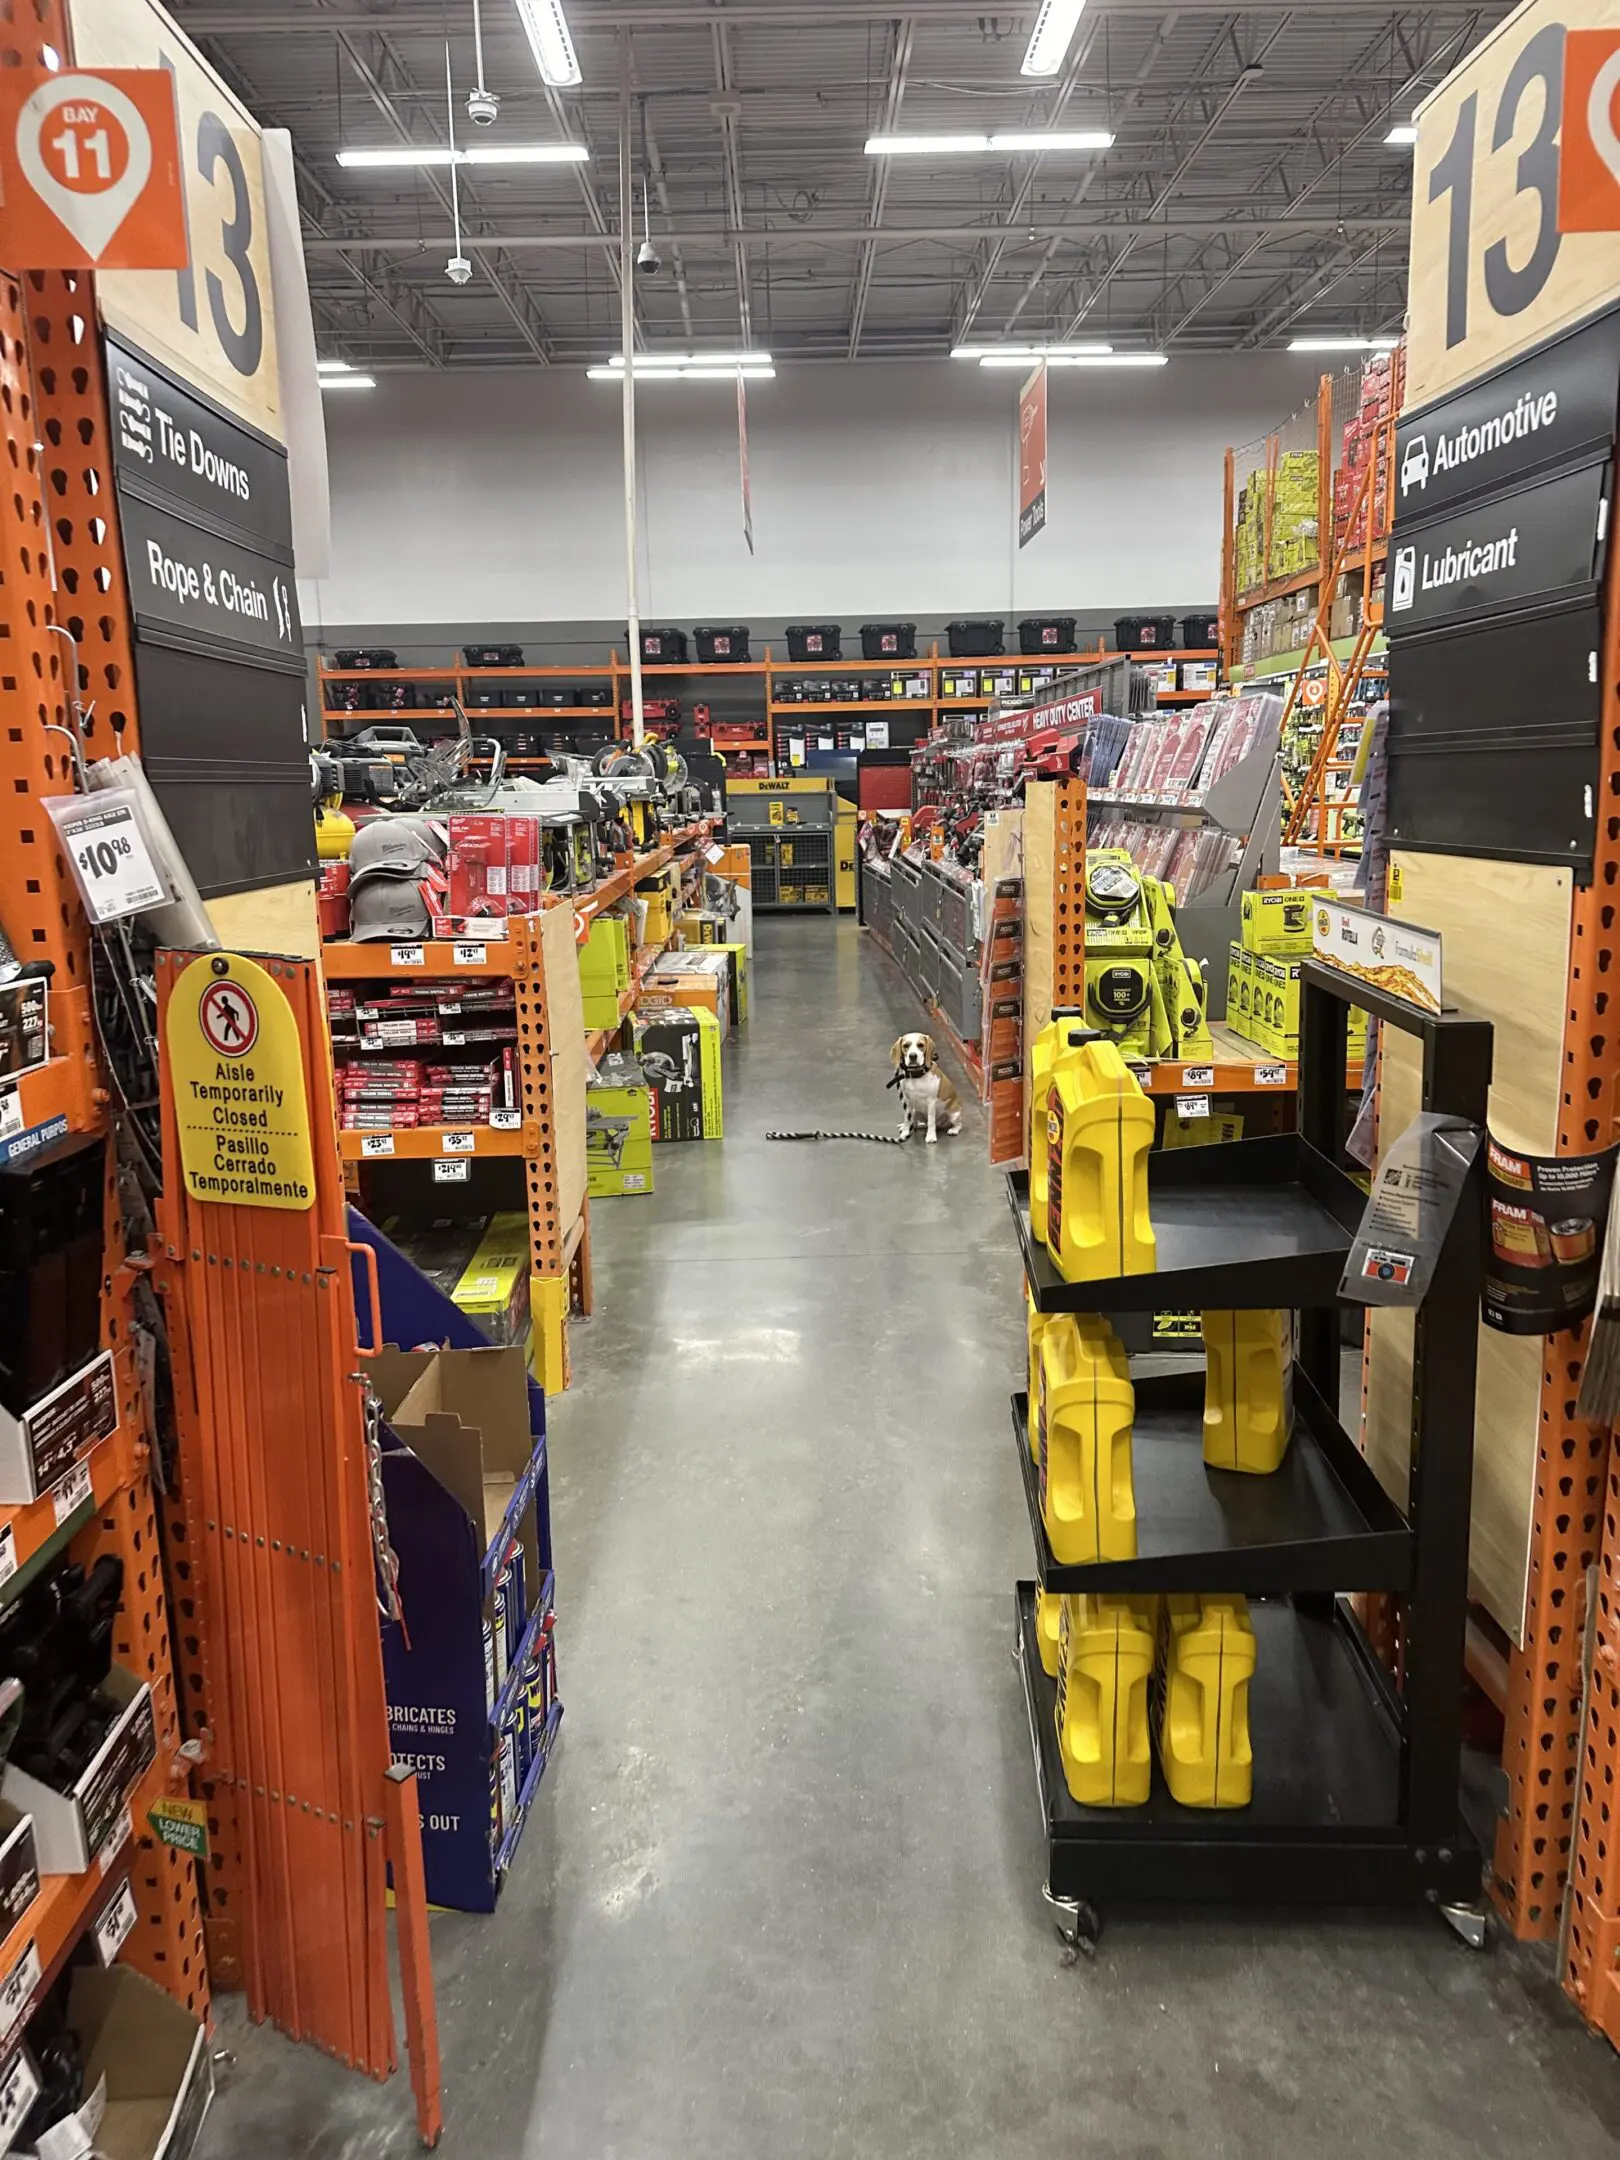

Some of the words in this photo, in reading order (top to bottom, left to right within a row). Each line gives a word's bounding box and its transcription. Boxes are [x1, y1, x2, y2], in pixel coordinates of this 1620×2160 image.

[62, 106, 98, 124] BAY
[52, 128, 111, 179] 11
[1428, 22, 1567, 351] 13
[1432, 389, 1558, 476] Automotive
[155, 407, 187, 466] Tie
[189, 429, 250, 500] Downs
[1032, 498, 1044, 527] Tools
[1421, 528, 1518, 591] Lubricant
[146, 539, 200, 604] Rope
[203, 562, 219, 605] &
[219, 568, 269, 621] Chain
[1033, 710, 1051, 730] HEAVY
[1050, 705, 1067, 726] DUTY
[1066, 695, 1095, 722] CENTER
[215, 1062, 255, 1082] Aisle
[190, 1081, 284, 1107] Temporarily
[213, 1105, 268, 1128] Closed
[8, 1130, 41, 1157] GENERAL
[40, 1118, 69, 1141] PURPOS
[216, 1135, 269, 1156] Pasillo
[214, 1155, 276, 1176] Cerrado
[1490, 1147, 1522, 1175] FRAM
[189, 1171, 309, 1200] Temporalmente
[1492, 1199, 1527, 1219] FRAM
[386, 1705, 457, 1725] BRICATES
[392, 1722, 418, 1732] CHAINS
[420, 1724, 426, 1732] &
[428, 1725, 454, 1734] HINGES
[417, 1771, 431, 1780] UST
[162, 1801, 193, 1820] NEW
[158, 1818, 201, 1838] LOWER
[429, 1814, 460, 1831] OUT
[162, 1830, 199, 1850] PRICE
